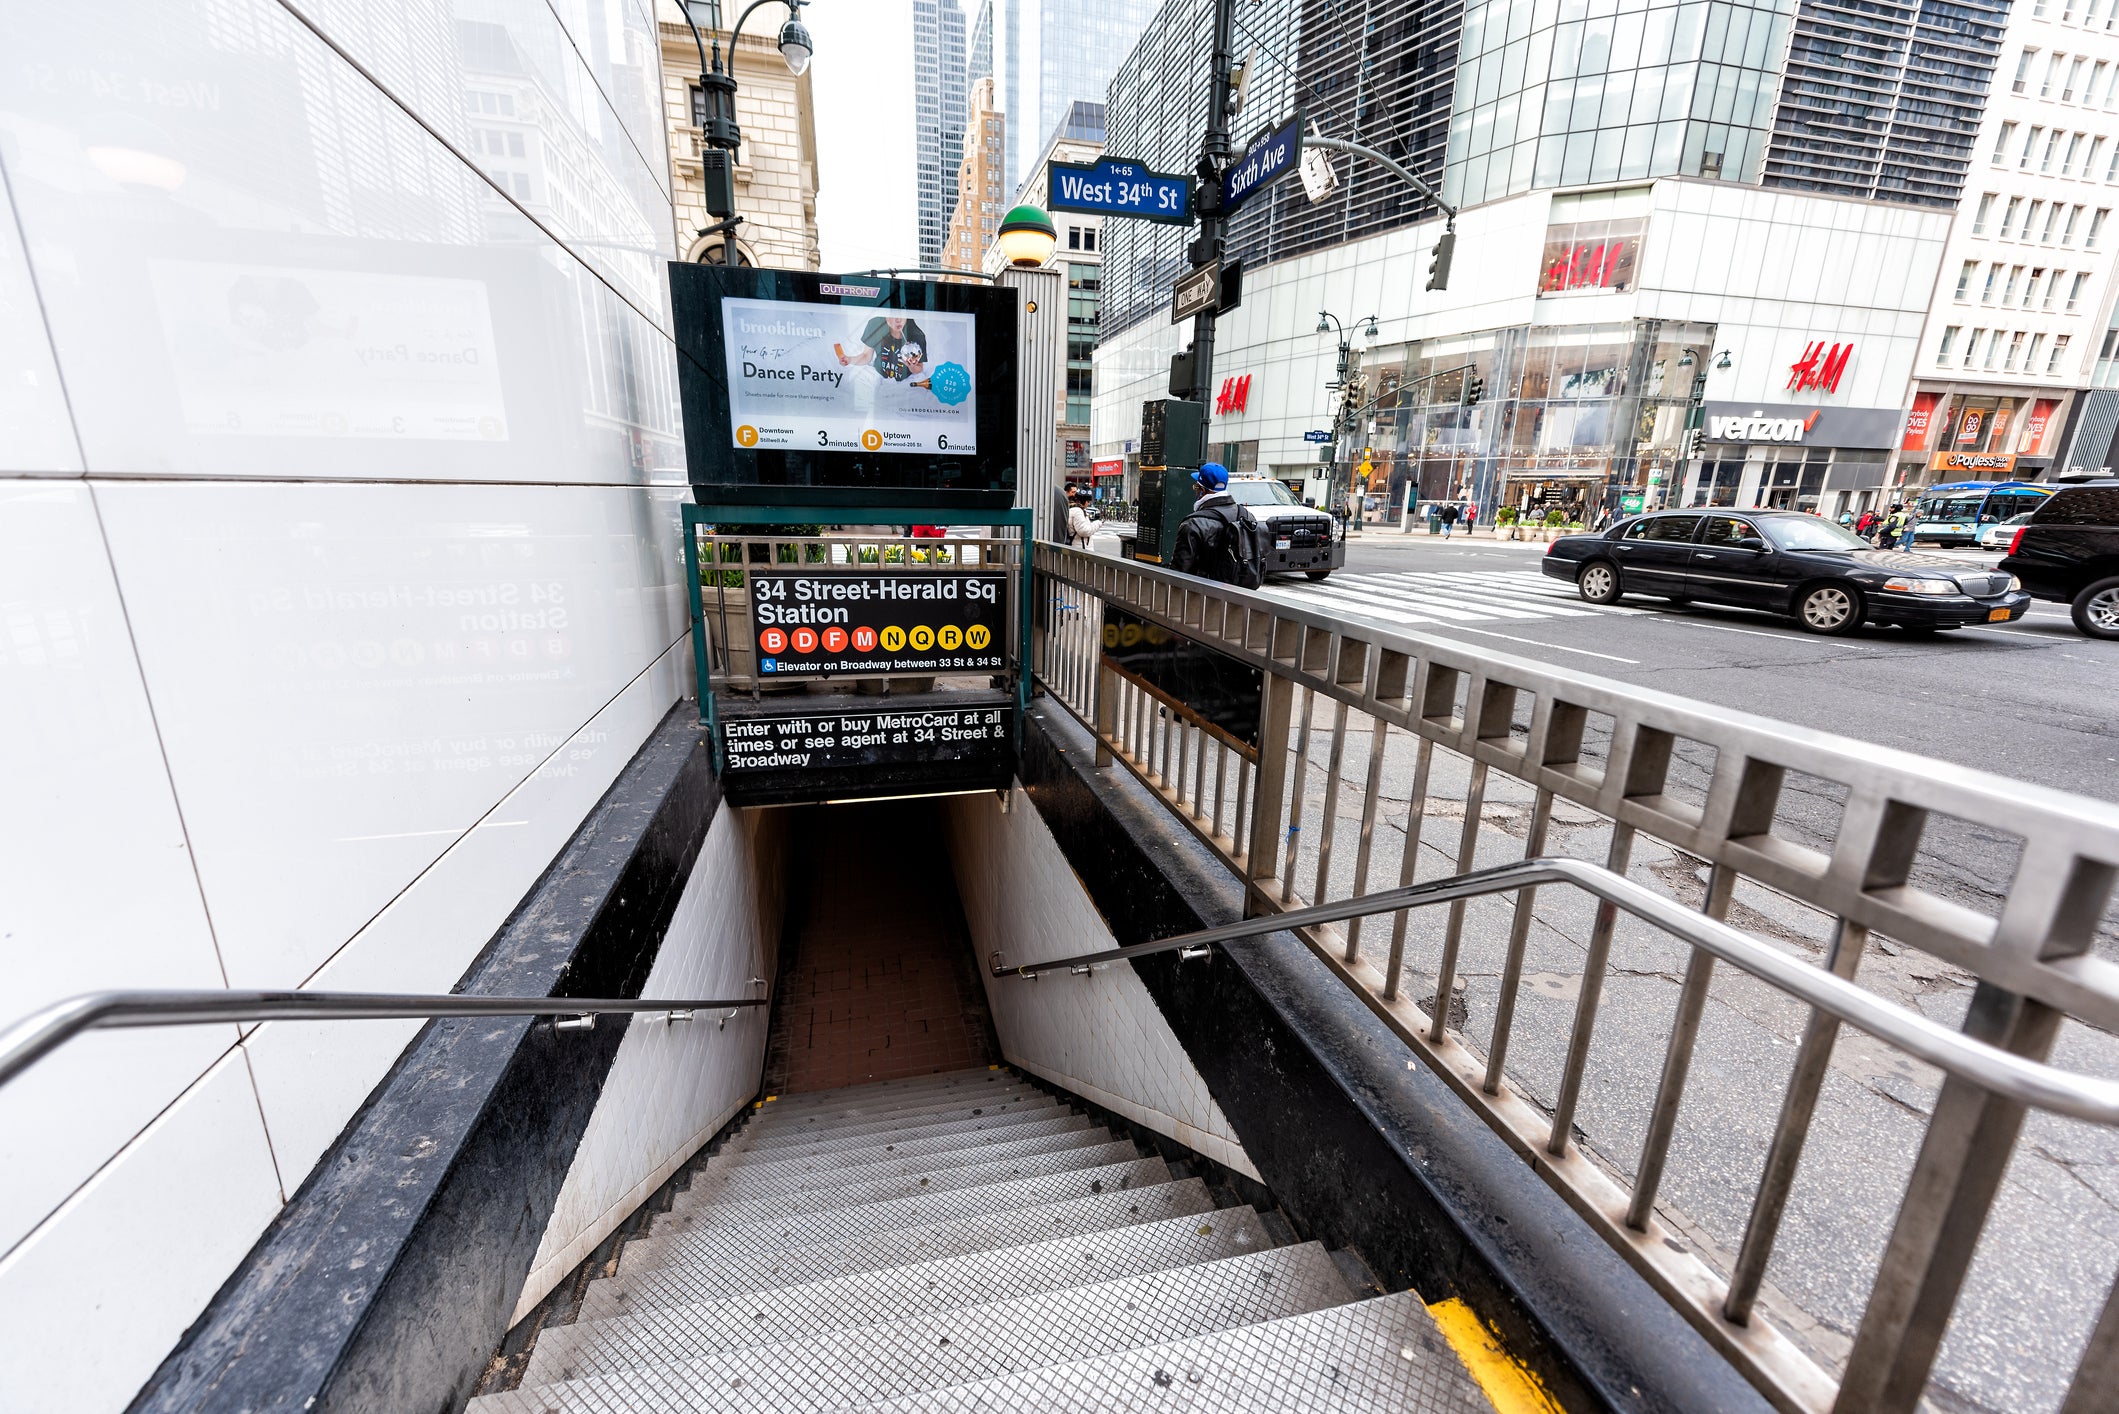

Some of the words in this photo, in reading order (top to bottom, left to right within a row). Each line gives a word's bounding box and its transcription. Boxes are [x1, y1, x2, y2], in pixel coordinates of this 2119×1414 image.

[1230, 162, 1258, 199] Sixth
[1260, 143, 1285, 174] Ave
[1061, 176, 1112, 204] West
[1117, 181, 1153, 206] 34th
[1158, 186, 1178, 210] St
[1545, 242, 1624, 291] H&M
[822, 285, 877, 297] OUTFRONT
[1180, 289, 1193, 306] ONE
[1197, 281, 1211, 299] WAY
[740, 318, 823, 338] brooklinen
[742, 361, 796, 380] Dance
[800, 364, 844, 388] Party
[1786, 340, 1854, 395] H&M
[1216, 374, 1252, 416] H&M
[1711, 410, 1805, 442] verizon
[1966, 424, 1977, 432] go
[1968, 416, 1978, 424] bo
[742, 430, 752, 442] F
[817, 430, 828, 446] 3
[867, 434, 878, 446] D
[938, 434, 948, 450] 6
[1956, 454, 1995, 468] Payless
[756, 580, 786, 600] 34
[794, 580, 958, 600] Street-Herald
[965, 579, 996, 604] Sq
[758, 603, 848, 624] Station
[768, 633, 782, 648] B
[798, 632, 812, 648] D
[829, 632, 840, 647] F
[857, 631, 873, 646] M
[888, 632, 900, 646] N
[916, 631, 928, 645] Q
[945, 630, 957, 644] R
[970, 630, 986, 644] W
[777, 661, 821, 672] Elevator
[824, 662, 838, 670] on
[840, 660, 892, 670] Broadway
[894, 659, 936, 668] between
[939, 658, 951, 667] 33
[953, 658, 964, 667] St
[966, 658, 974, 667] &
[976, 658, 988, 666] 34
[991, 657, 1002, 666] St
[726, 722, 770, 738] Enter
[776, 720, 812, 734] with
[818, 721, 835, 732] or
[841, 718, 870, 733] buy
[876, 712, 958, 730] MetroCard
[964, 712, 979, 725] at
[984, 710, 1000, 723] all
[727, 739, 774, 753] times
[780, 738, 798, 750] or
[804, 737, 835, 748] see
[841, 732, 886, 749] agent
[892, 730, 908, 743] at
[914, 729, 935, 742] 34
[941, 726, 987, 740] Street
[994, 725, 1005, 738] &
[728, 752, 811, 769] Broadway
